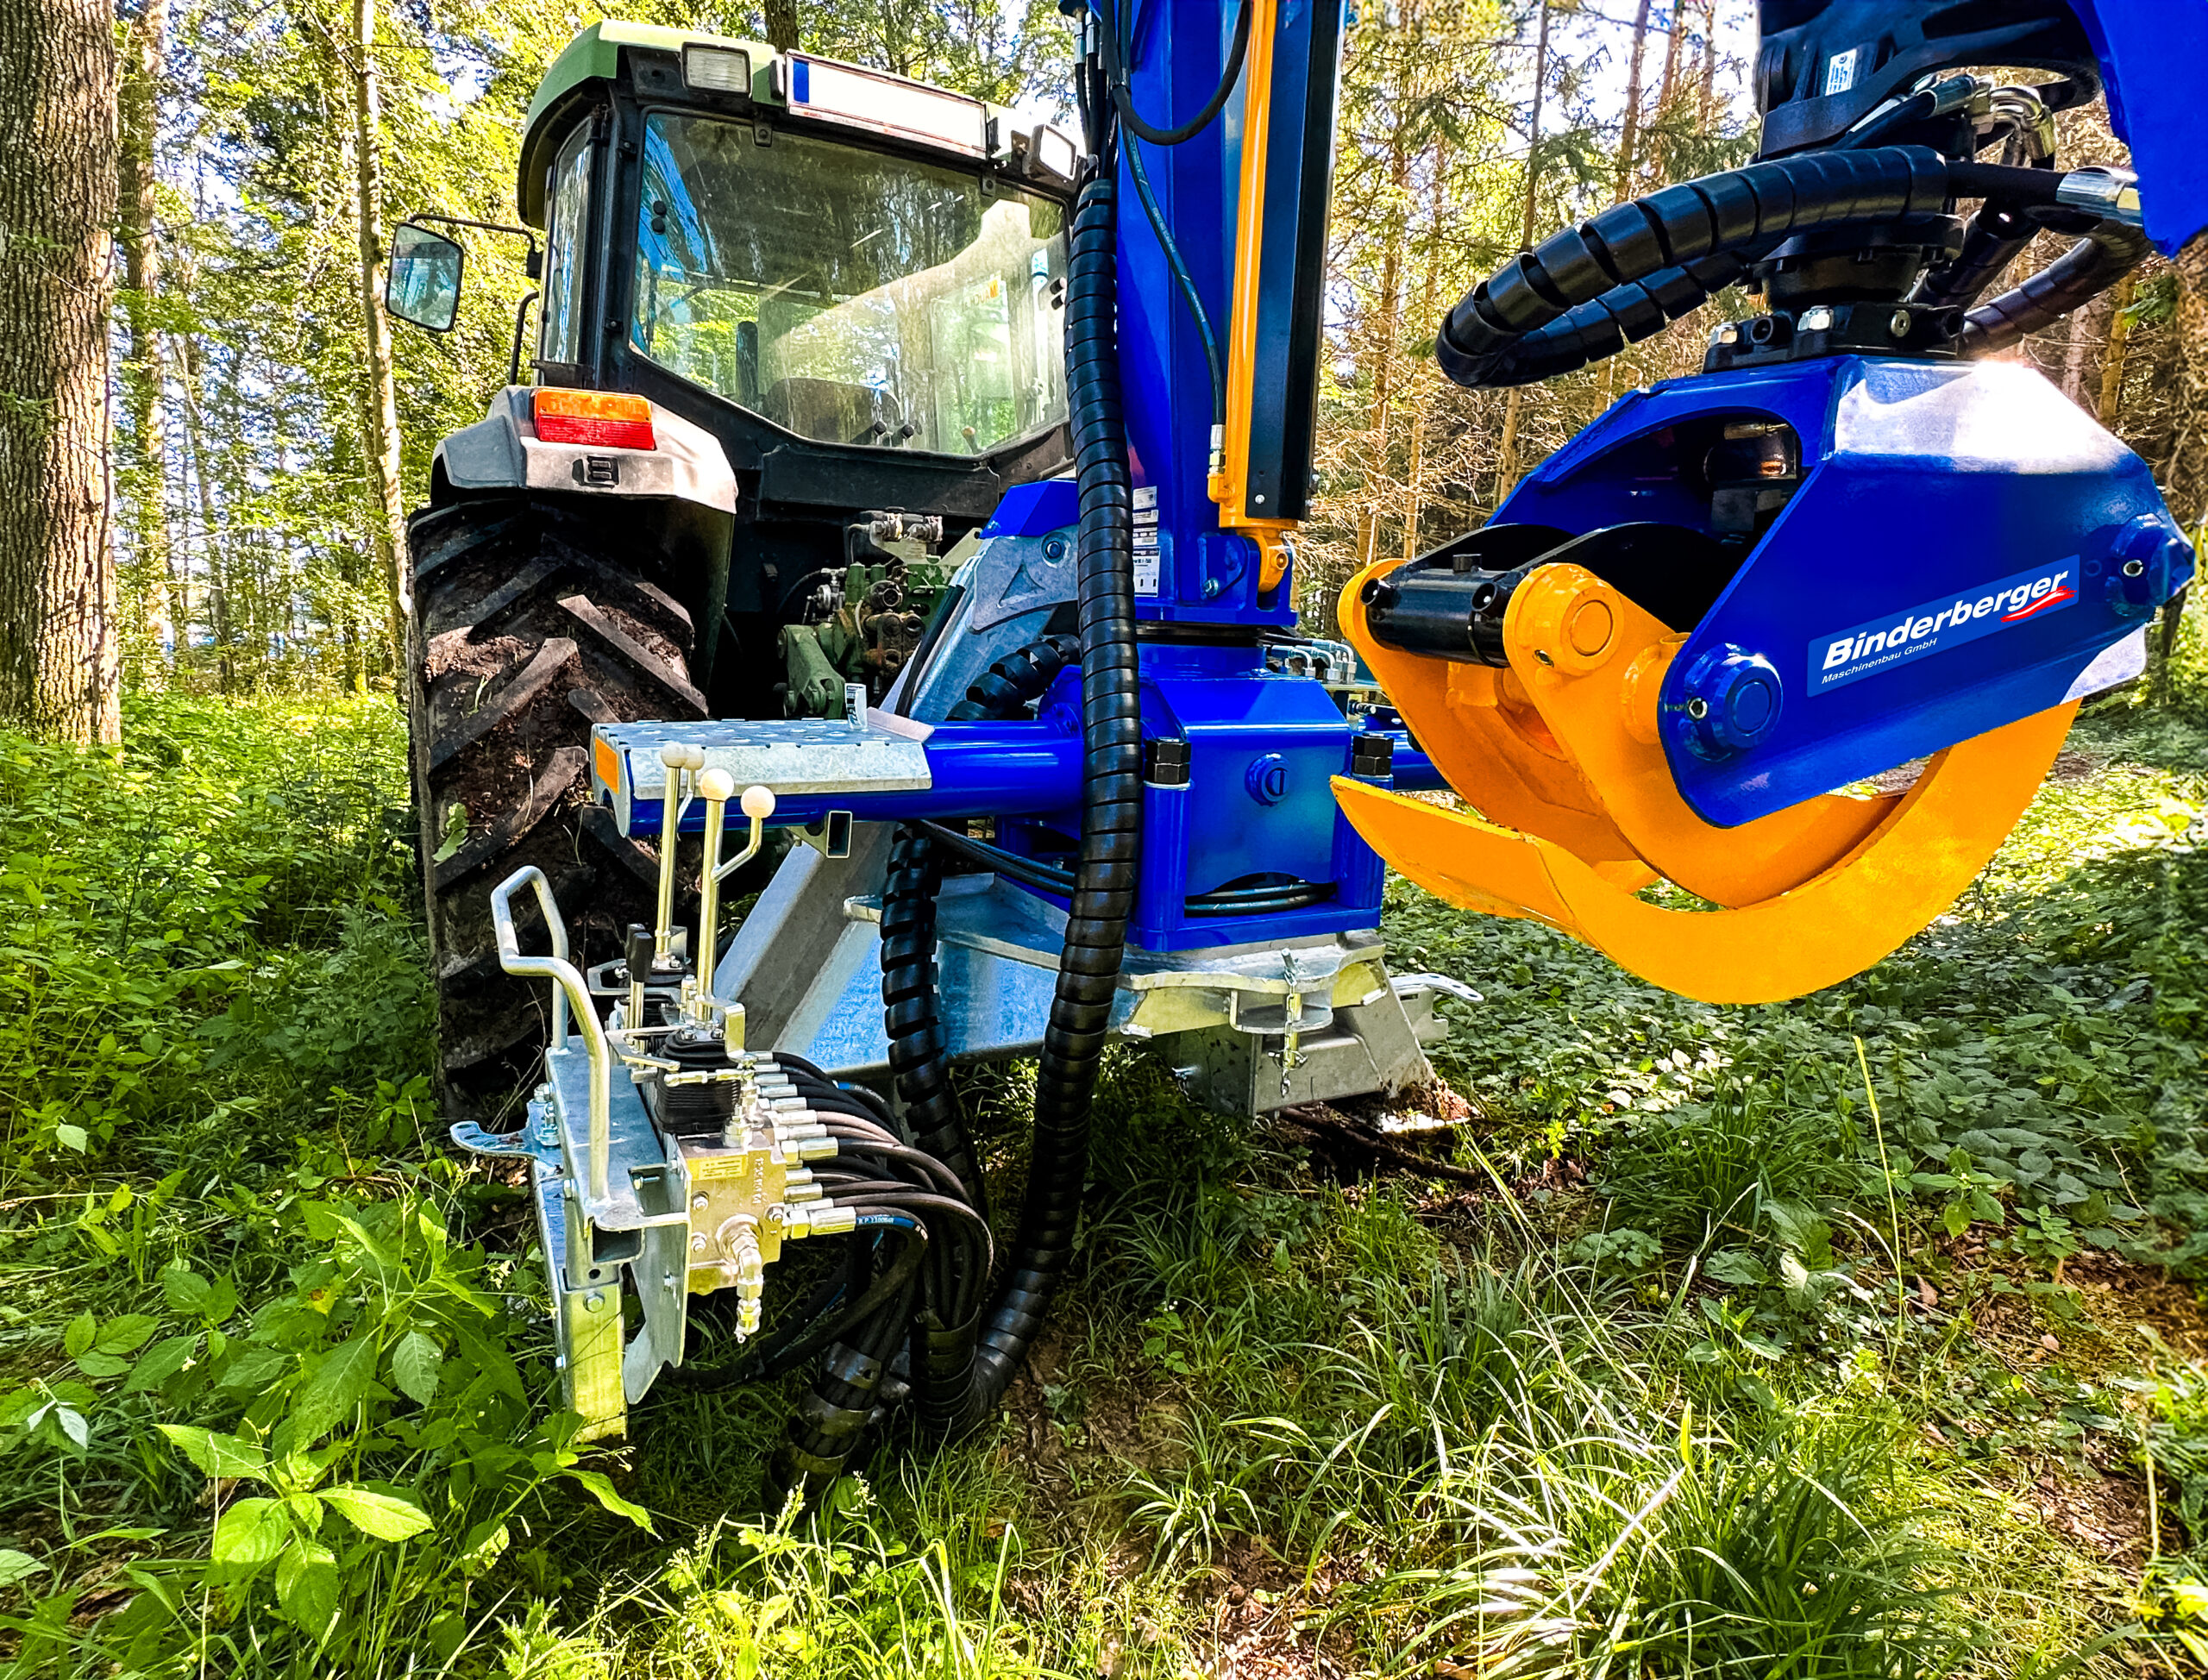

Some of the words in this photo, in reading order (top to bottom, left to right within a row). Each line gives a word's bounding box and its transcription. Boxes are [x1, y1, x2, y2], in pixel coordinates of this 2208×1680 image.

[1822, 570, 2069, 670] Binderberger
[1822, 651, 1901, 684] Maschinenbau
[1904, 637, 1938, 655] GmbH
